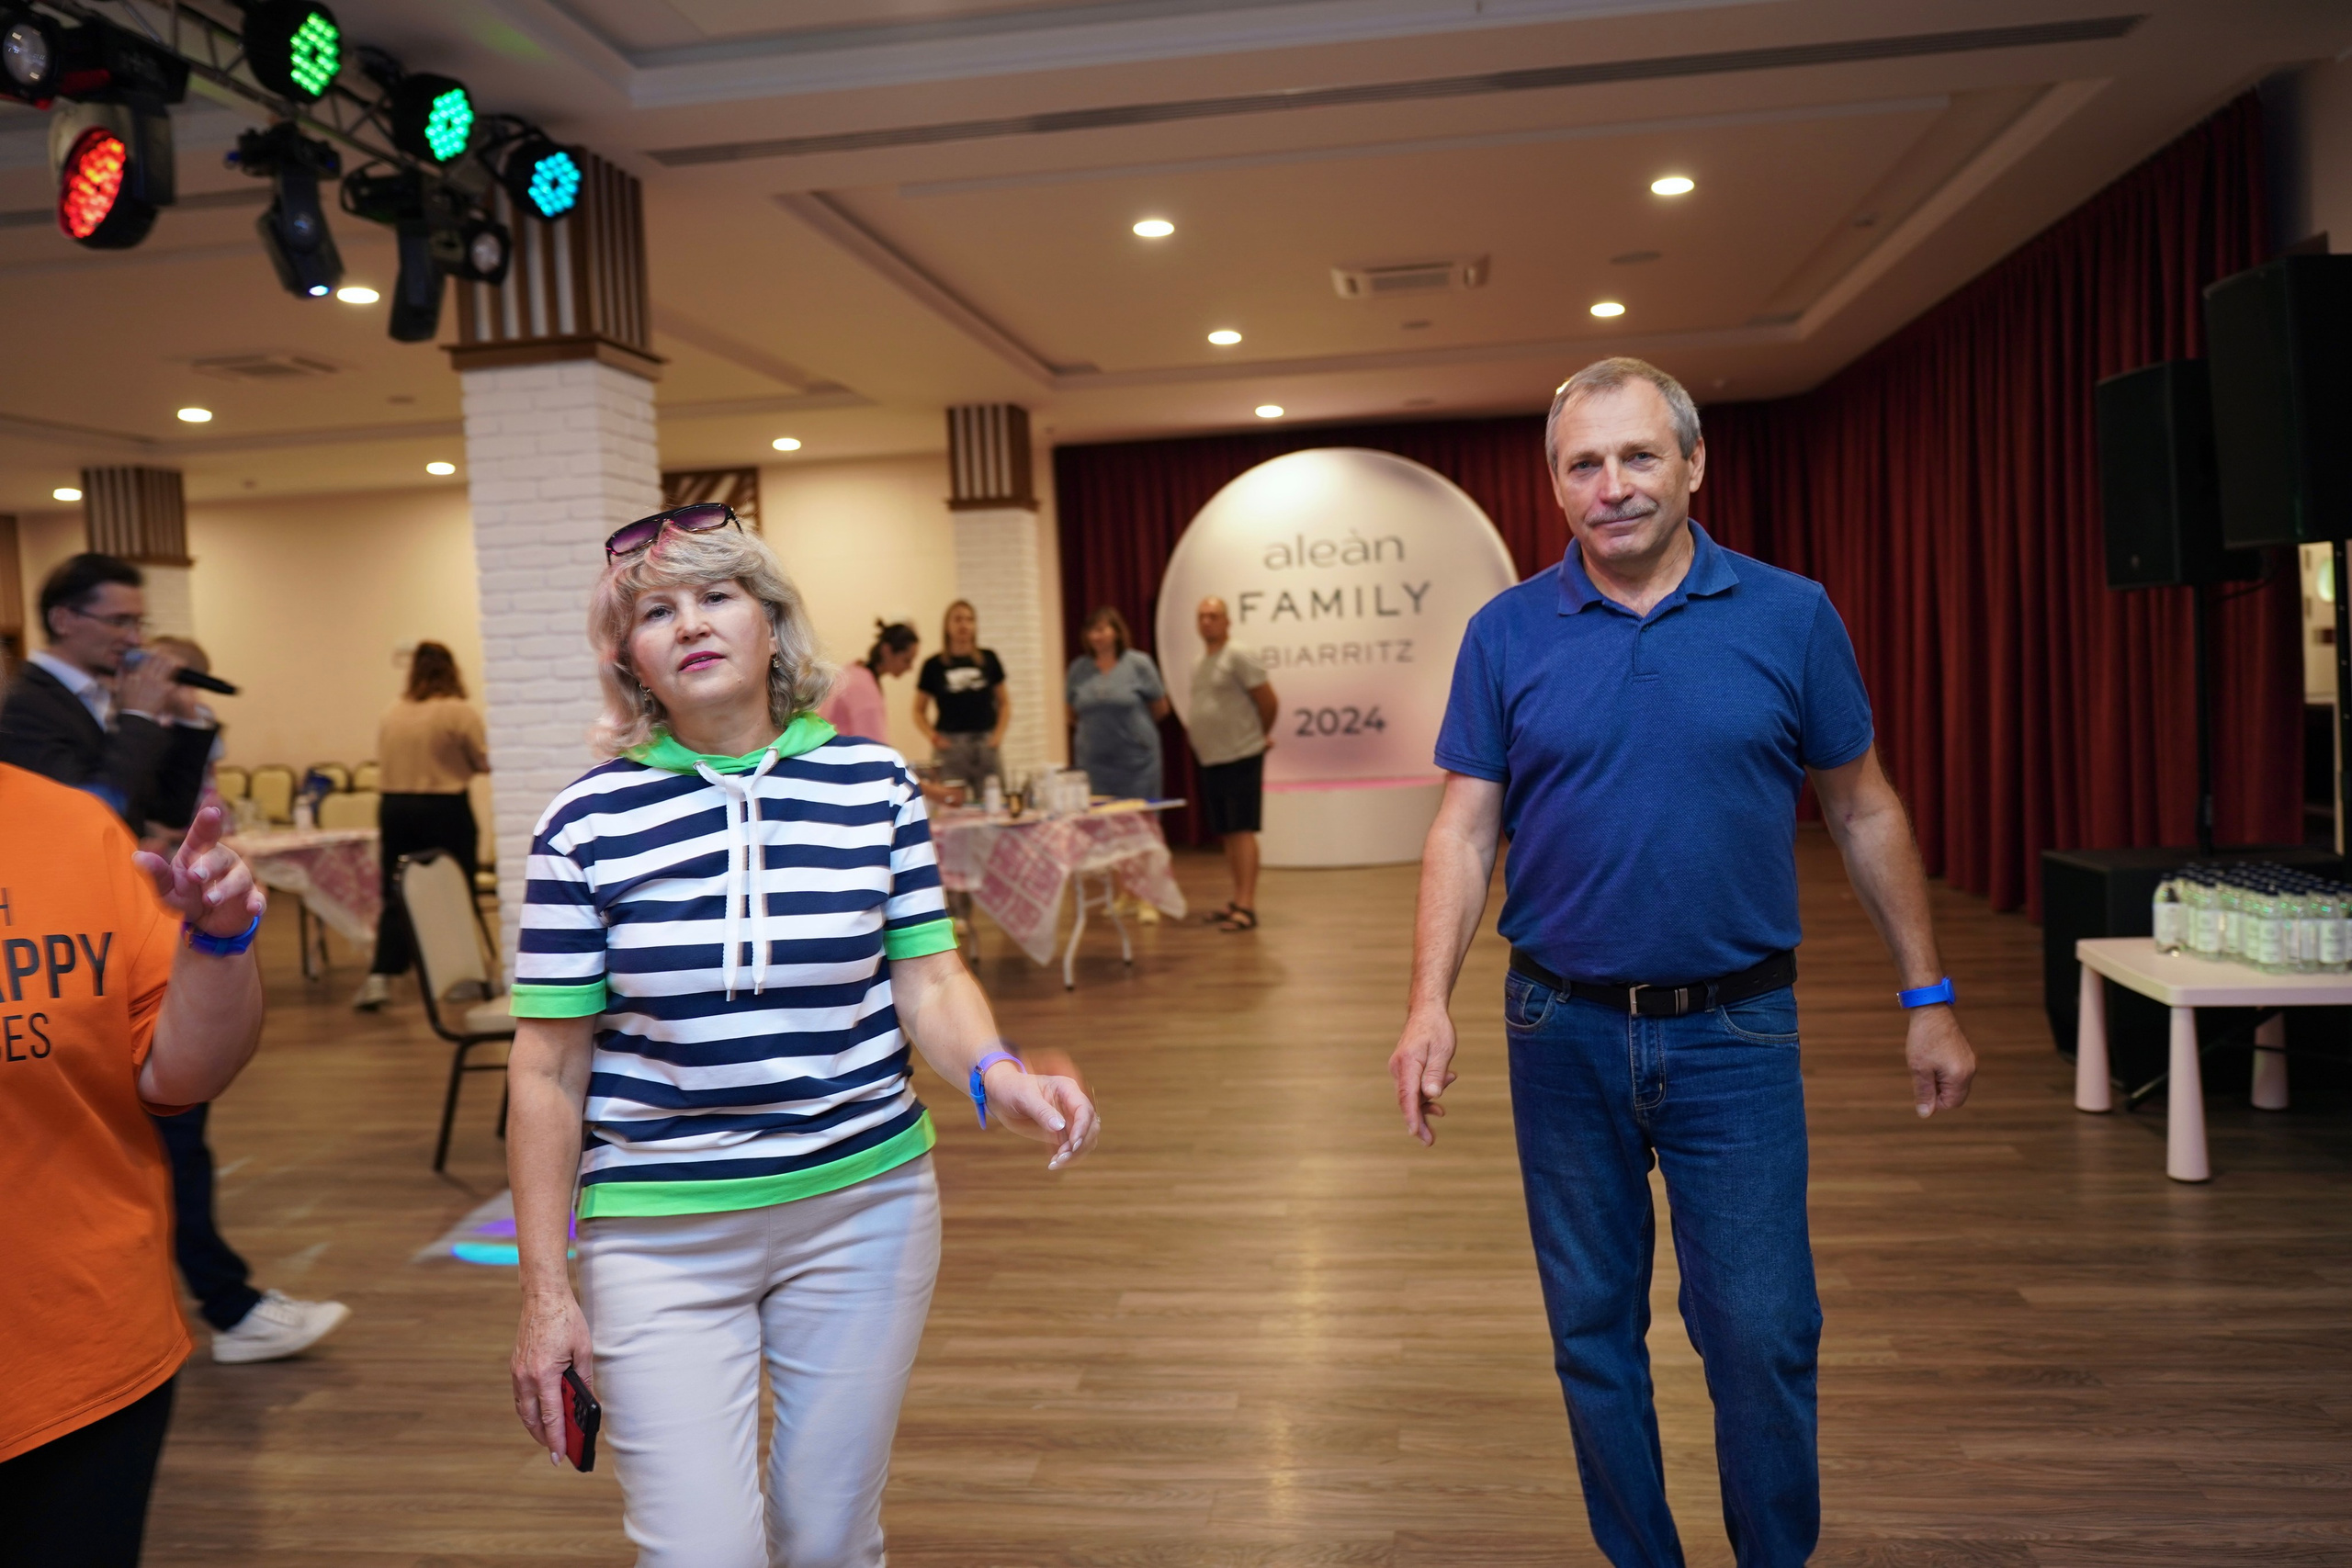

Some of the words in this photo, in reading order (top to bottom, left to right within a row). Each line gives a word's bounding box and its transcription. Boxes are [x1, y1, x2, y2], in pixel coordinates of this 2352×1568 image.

[1263, 528, 1405, 570] aleàn
[1238, 581, 1431, 624] FAMILY
[1261, 639, 1414, 670] BIARRITZ
[1294, 706, 1386, 737] 2024
[0, 931, 113, 1003] PPY
[0, 1012, 51, 1062] ES
